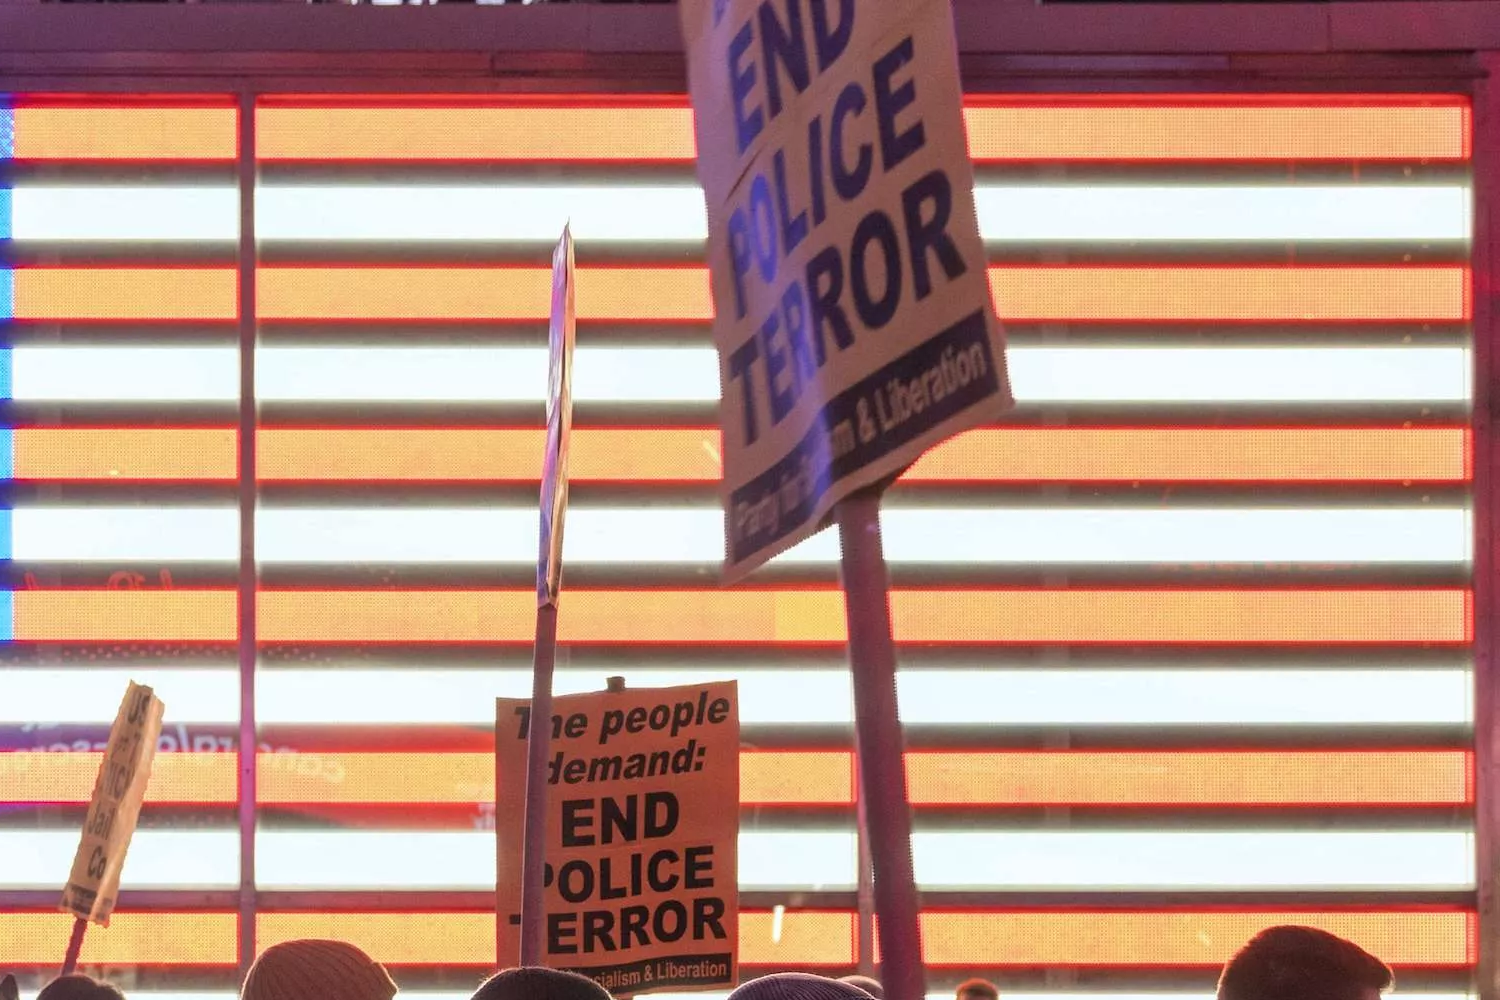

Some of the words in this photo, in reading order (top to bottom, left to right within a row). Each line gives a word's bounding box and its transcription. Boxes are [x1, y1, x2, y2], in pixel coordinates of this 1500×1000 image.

[727, 0, 855, 155] END
[727, 35, 927, 323] POLICE
[728, 168, 968, 448] TERROR
[876, 338, 987, 434] Liberation
[599, 691, 730, 745] people
[561, 791, 680, 848] END
[544, 845, 715, 904] OLICE
[509, 897, 727, 955] ERROR
[644, 965, 653, 981] &
[656, 960, 727, 981] Liberation
